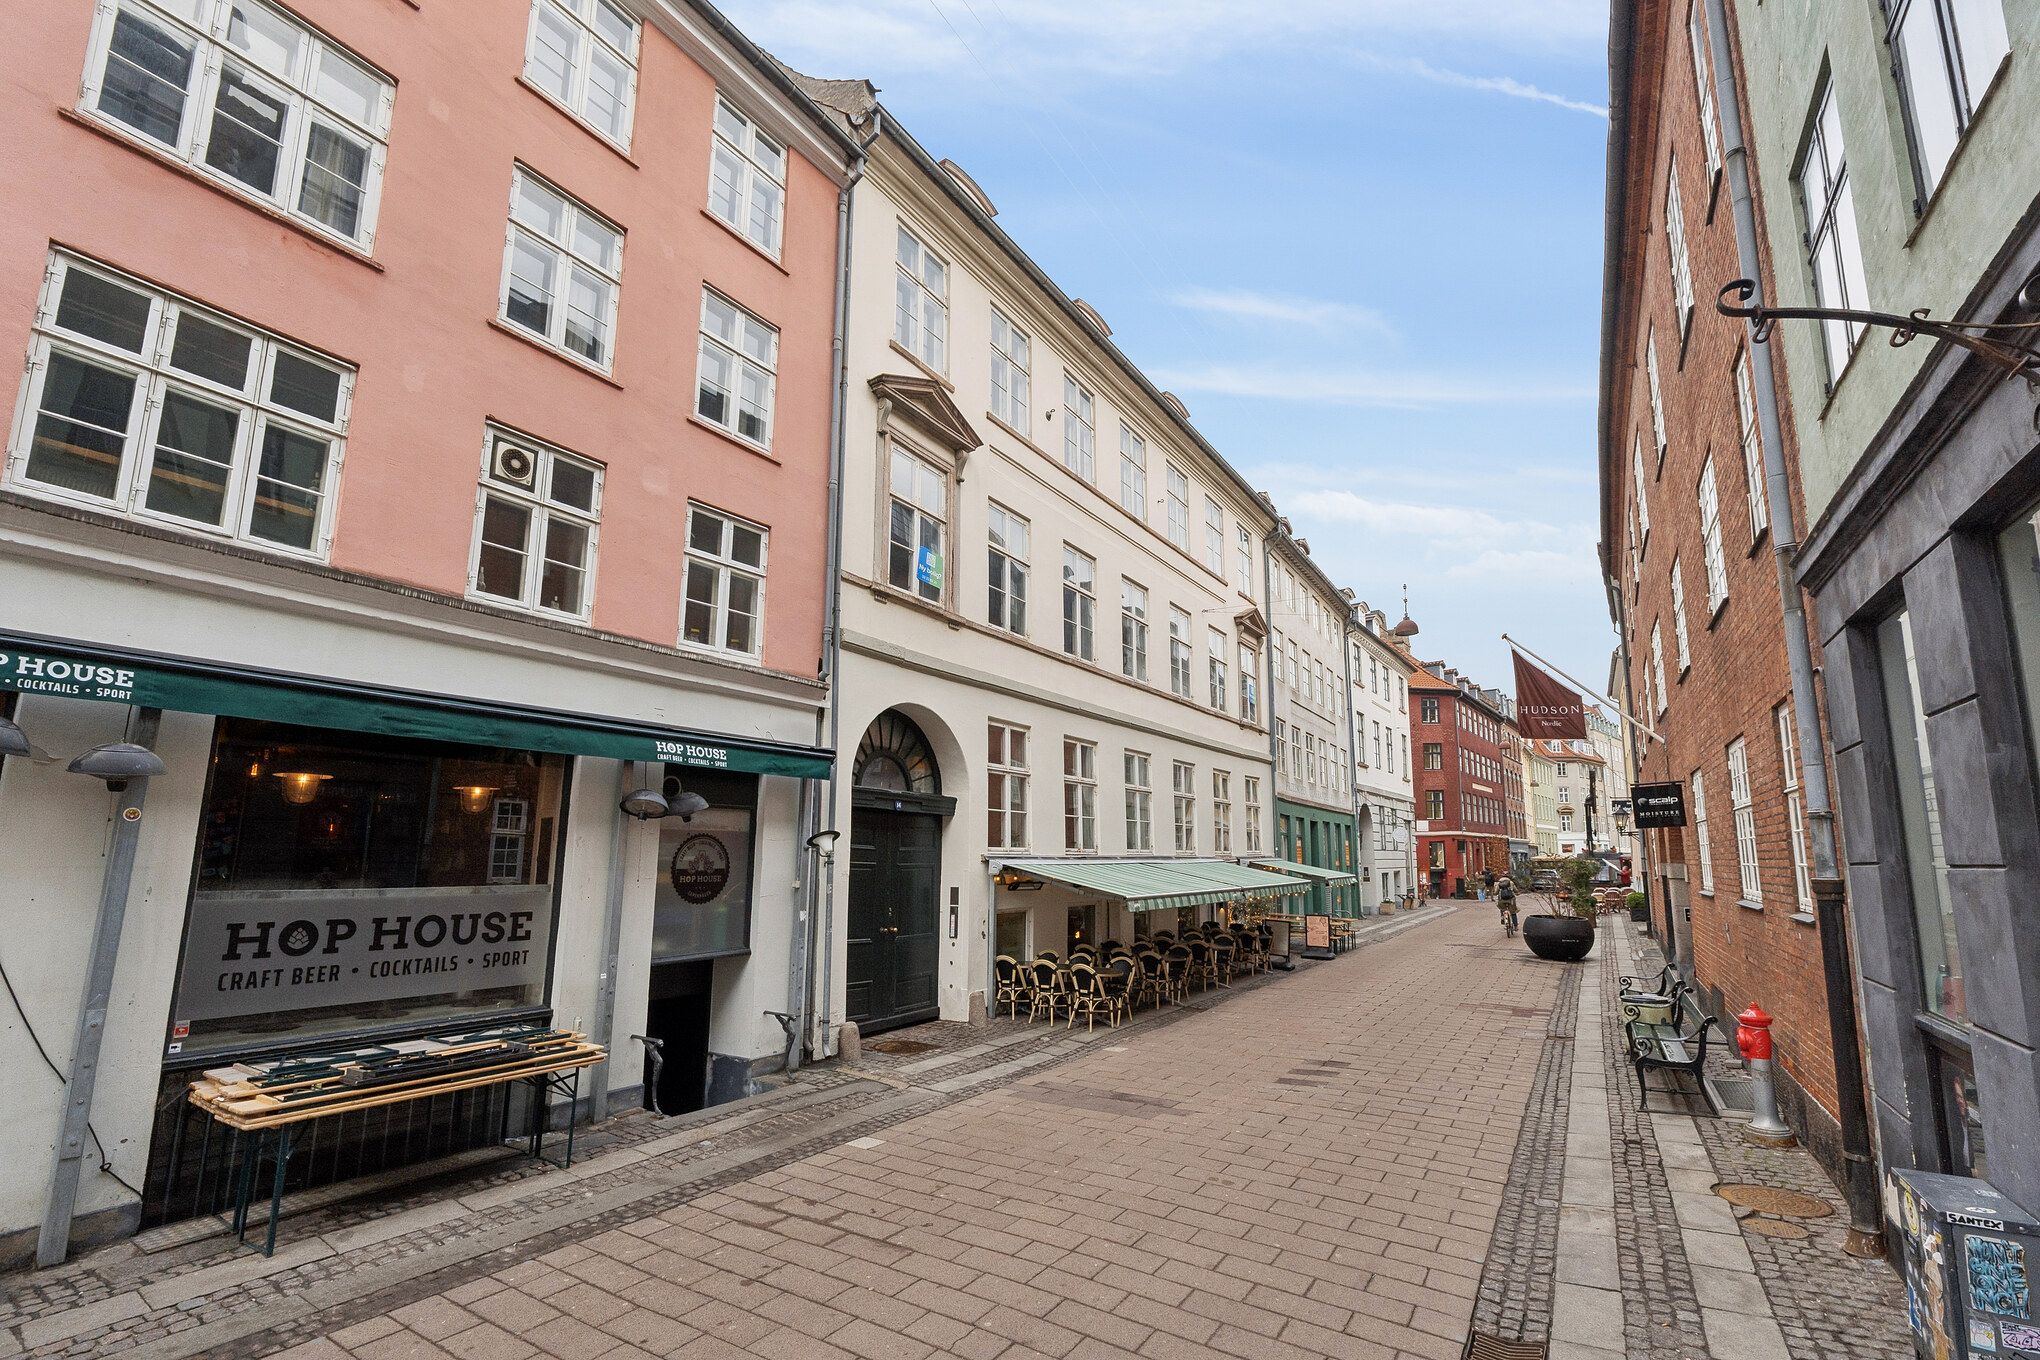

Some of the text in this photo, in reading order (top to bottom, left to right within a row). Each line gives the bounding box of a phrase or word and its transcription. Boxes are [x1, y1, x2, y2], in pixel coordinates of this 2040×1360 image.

[16, 655, 135, 688] HOUSE
[16, 678, 132, 700] COCKTAILS SPORT
[1520, 705, 1580, 715] HUDSON
[655, 741, 727, 760] HOP HOUSE
[657, 753, 672, 761] CRAFT
[688, 757, 710, 766] COCKTAILS
[714, 760, 728, 768] SPORT
[1648, 796, 1679, 805] scalp
[680, 875, 722, 883] HOP HOUSE
[222, 911, 534, 961] HOP HOUSE
[217, 950, 530, 992] CRAFT BEER COCKTAILS SPORT
[1948, 1213, 2002, 1230] SANTEX
